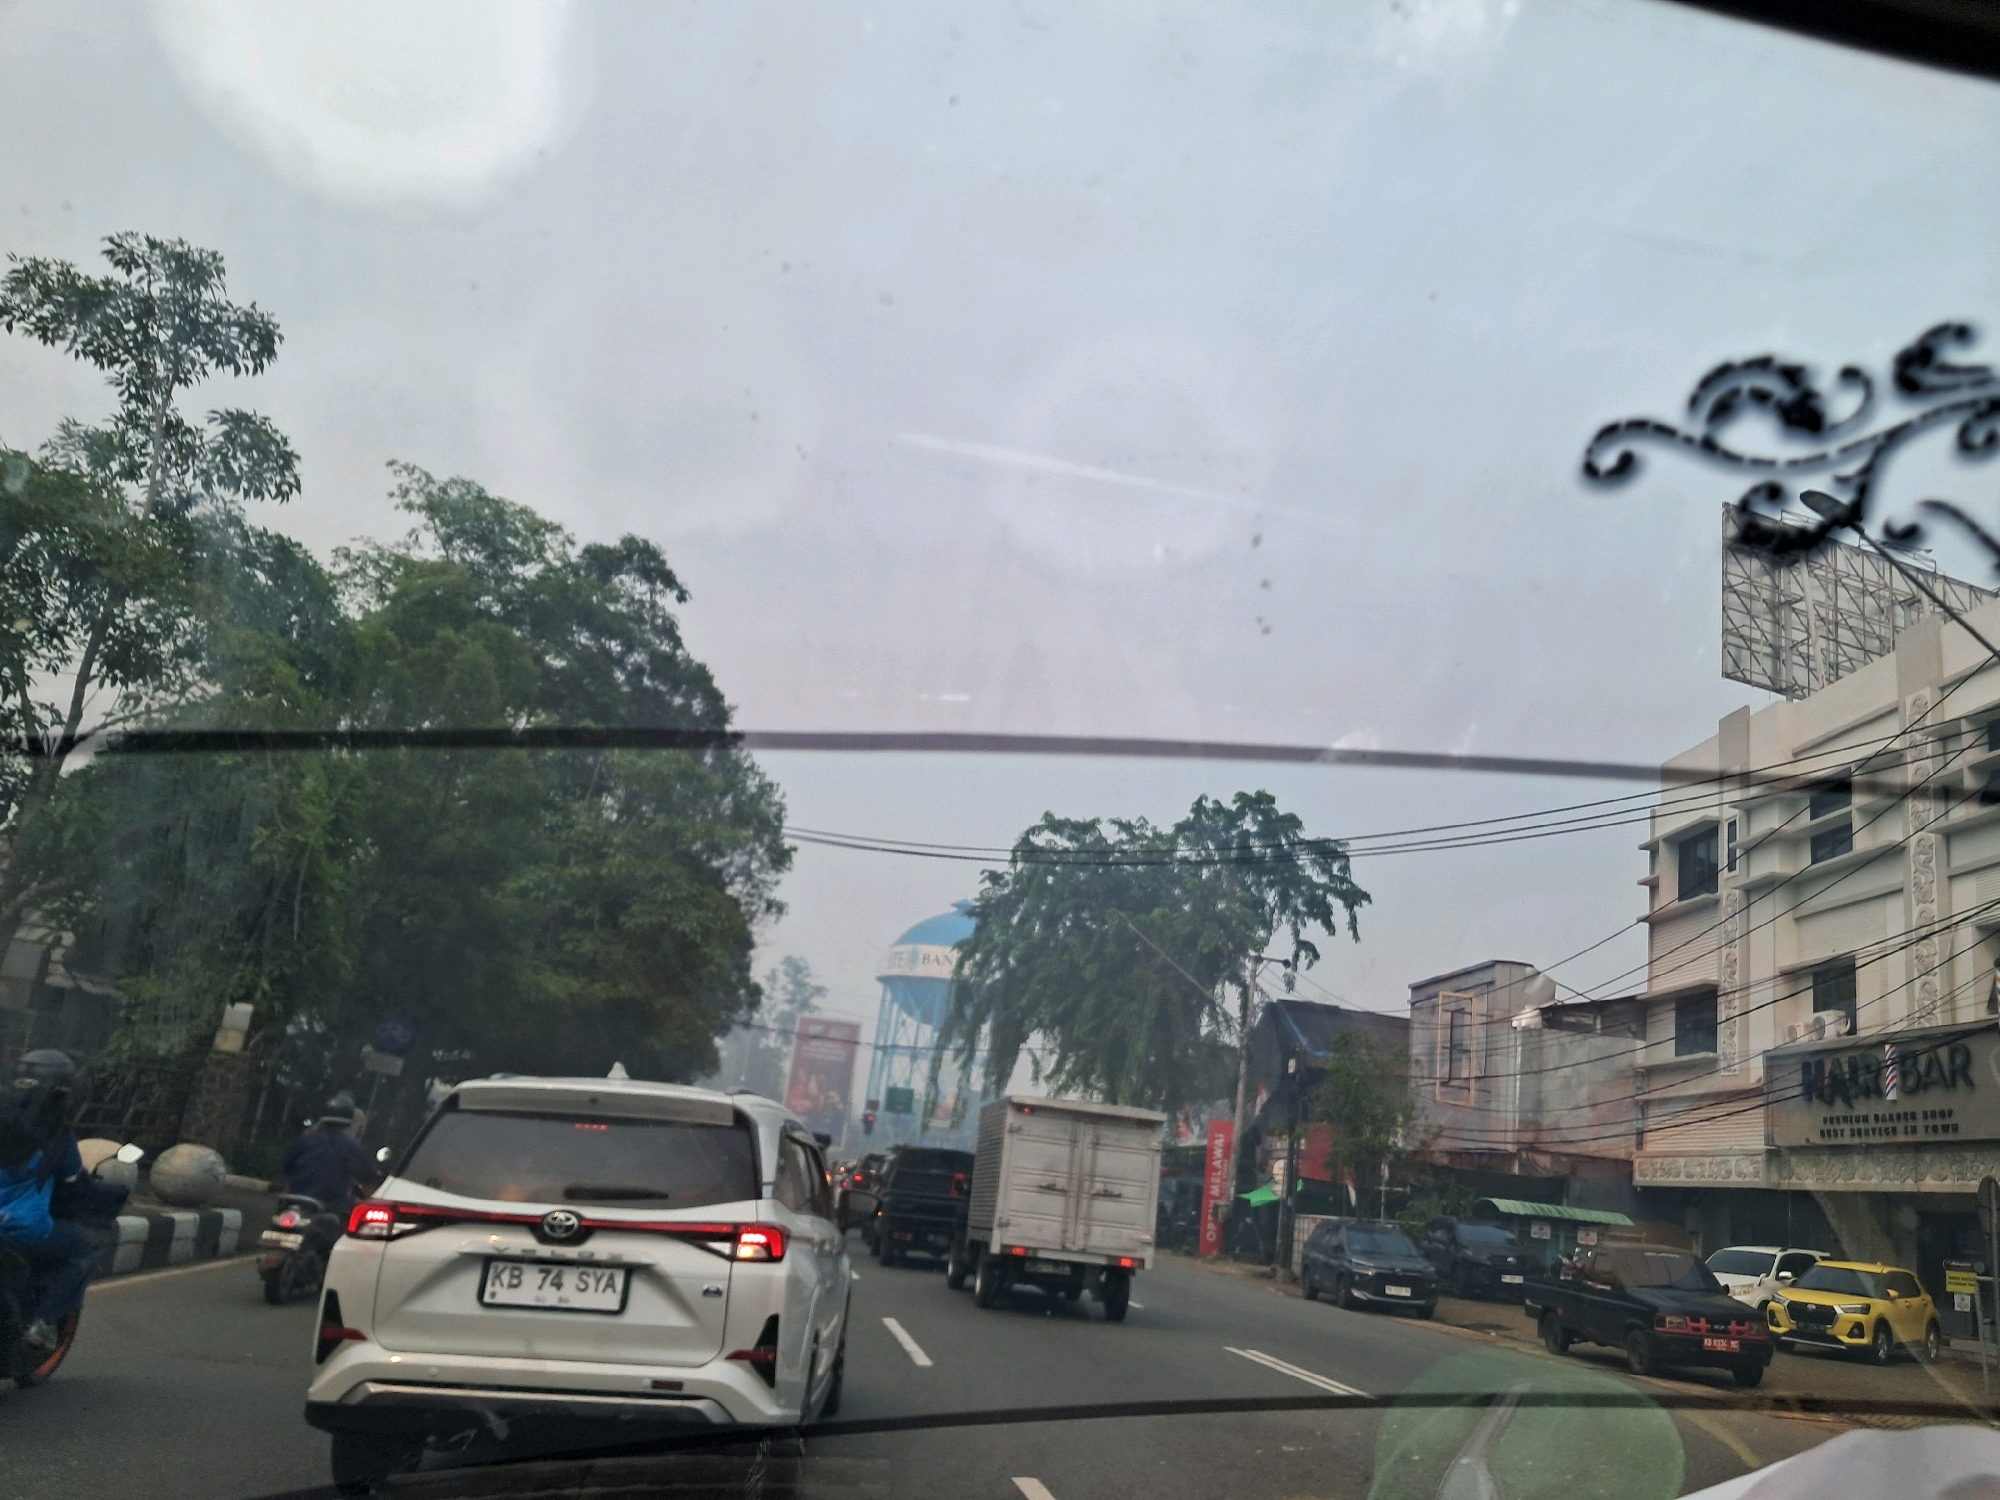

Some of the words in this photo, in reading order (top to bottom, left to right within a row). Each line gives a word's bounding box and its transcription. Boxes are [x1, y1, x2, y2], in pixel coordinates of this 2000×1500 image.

[921, 953, 956, 966] BAN
[1801, 1053, 1884, 1105] HAIR
[1899, 1042, 1976, 1094] BAR
[1822, 1113, 1870, 1126] PREMIUM
[1873, 1111, 1918, 1124] BARBER
[1921, 1109, 1954, 1120] SHOP
[1819, 1128, 1845, 1139] BEST
[1849, 1126, 1898, 1138] SERVICE
[1903, 1124, 1918, 1136] IN
[1923, 1123, 1960, 1135] TOWN
[1210, 1133, 1225, 1197] MELAWAI
[491, 1265, 524, 1290] KB
[537, 1267, 565, 1291] 74
[575, 1270, 617, 1294] SYA
